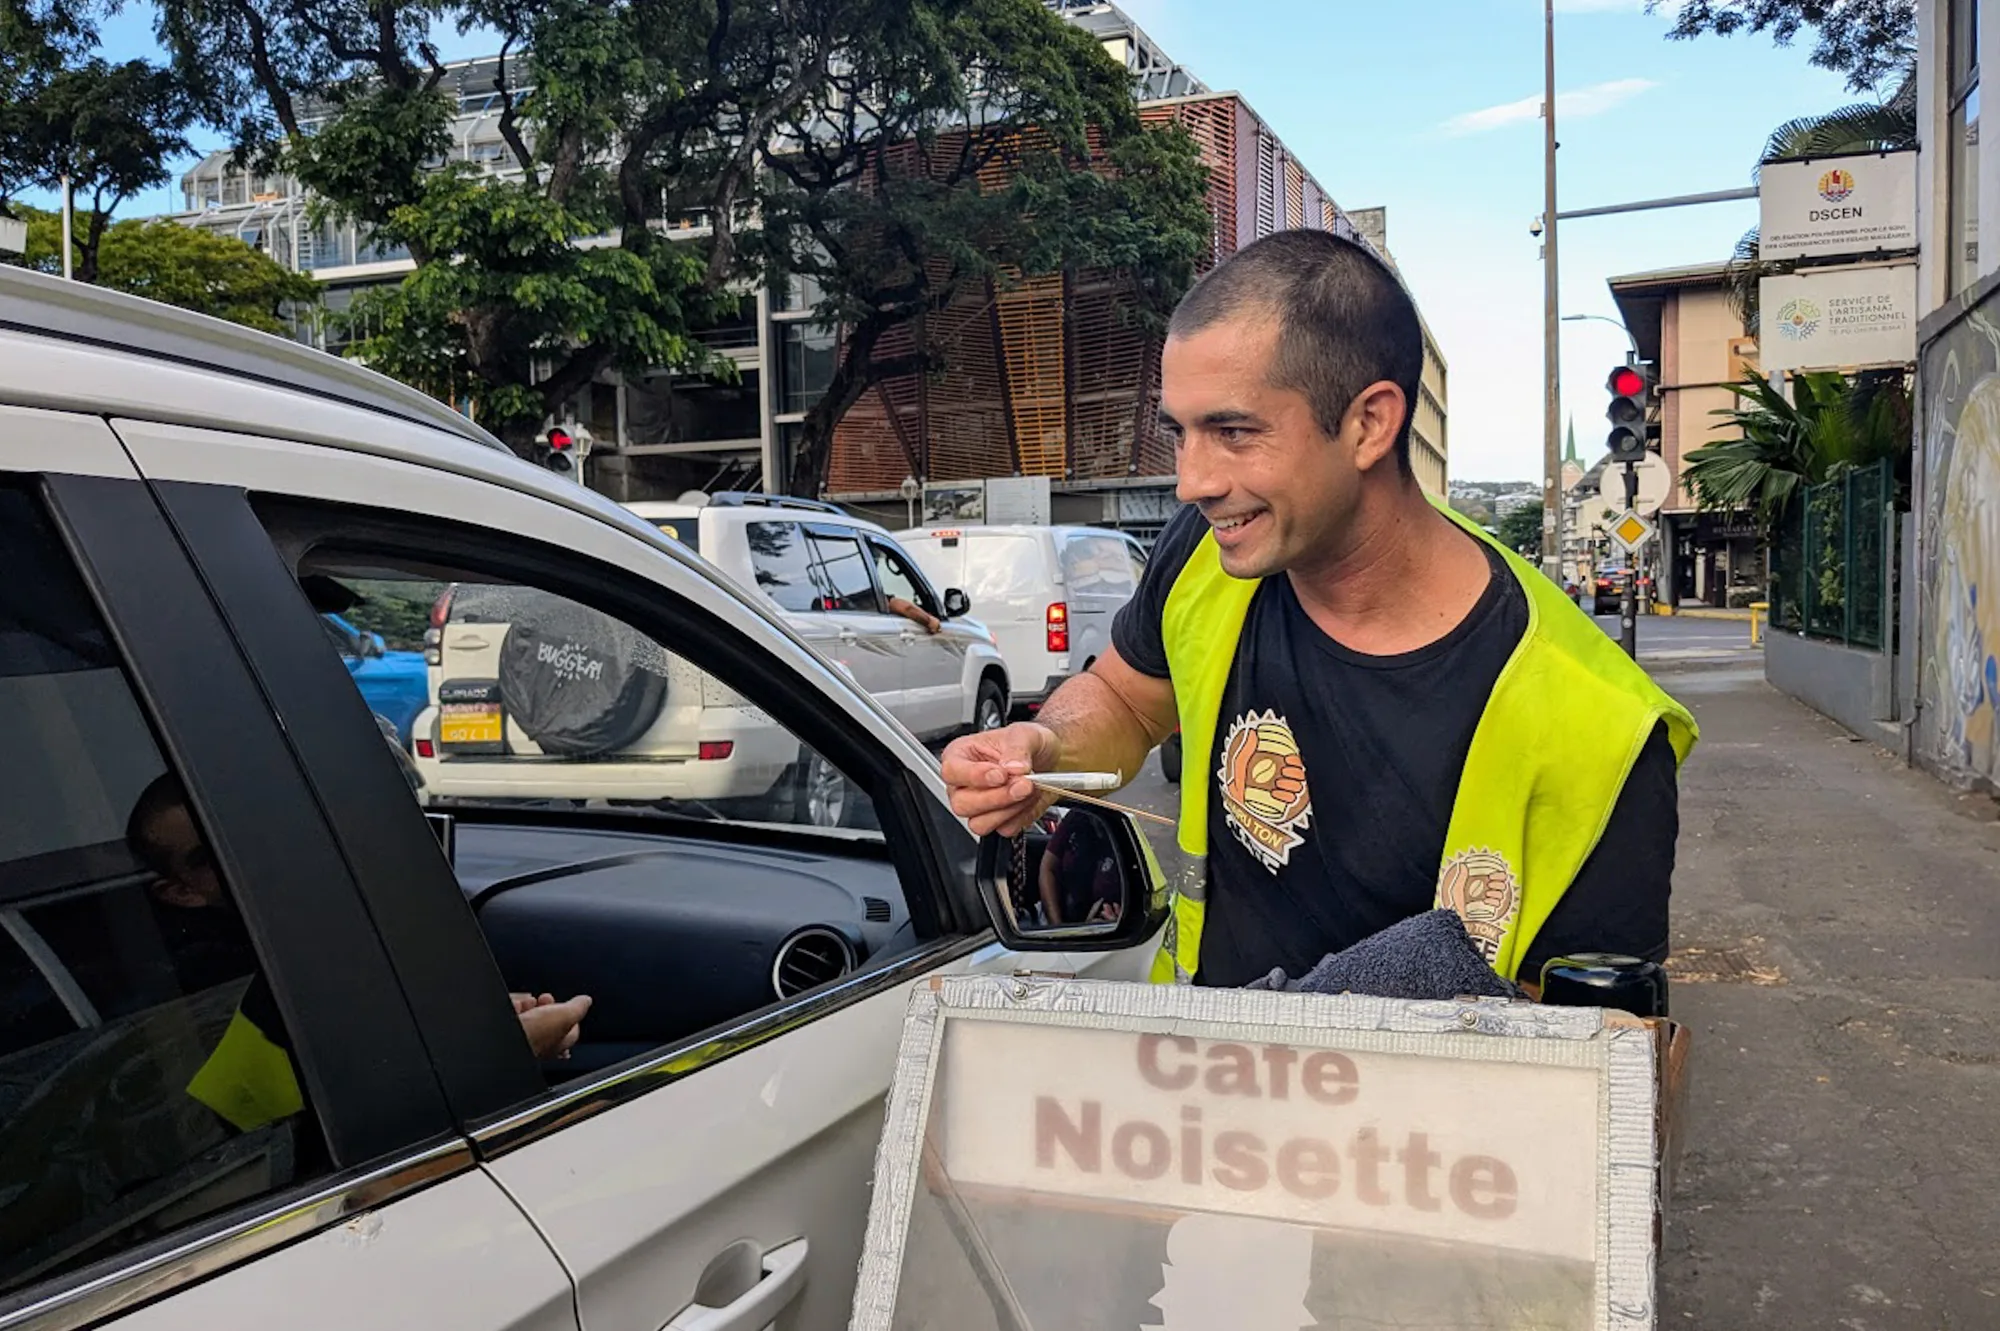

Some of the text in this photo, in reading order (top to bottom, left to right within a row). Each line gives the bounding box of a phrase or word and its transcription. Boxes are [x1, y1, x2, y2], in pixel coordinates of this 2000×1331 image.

[1809, 206, 1862, 222] DSCEN
[1829, 295, 1890, 307] SERVICE DE
[1829, 304, 1893, 316] L'ARTISANAT
[1829, 312, 1907, 324] TRADITIONNEL
[1252, 821, 1283, 847] TON
[1034, 1095, 1519, 1220] Noisette
